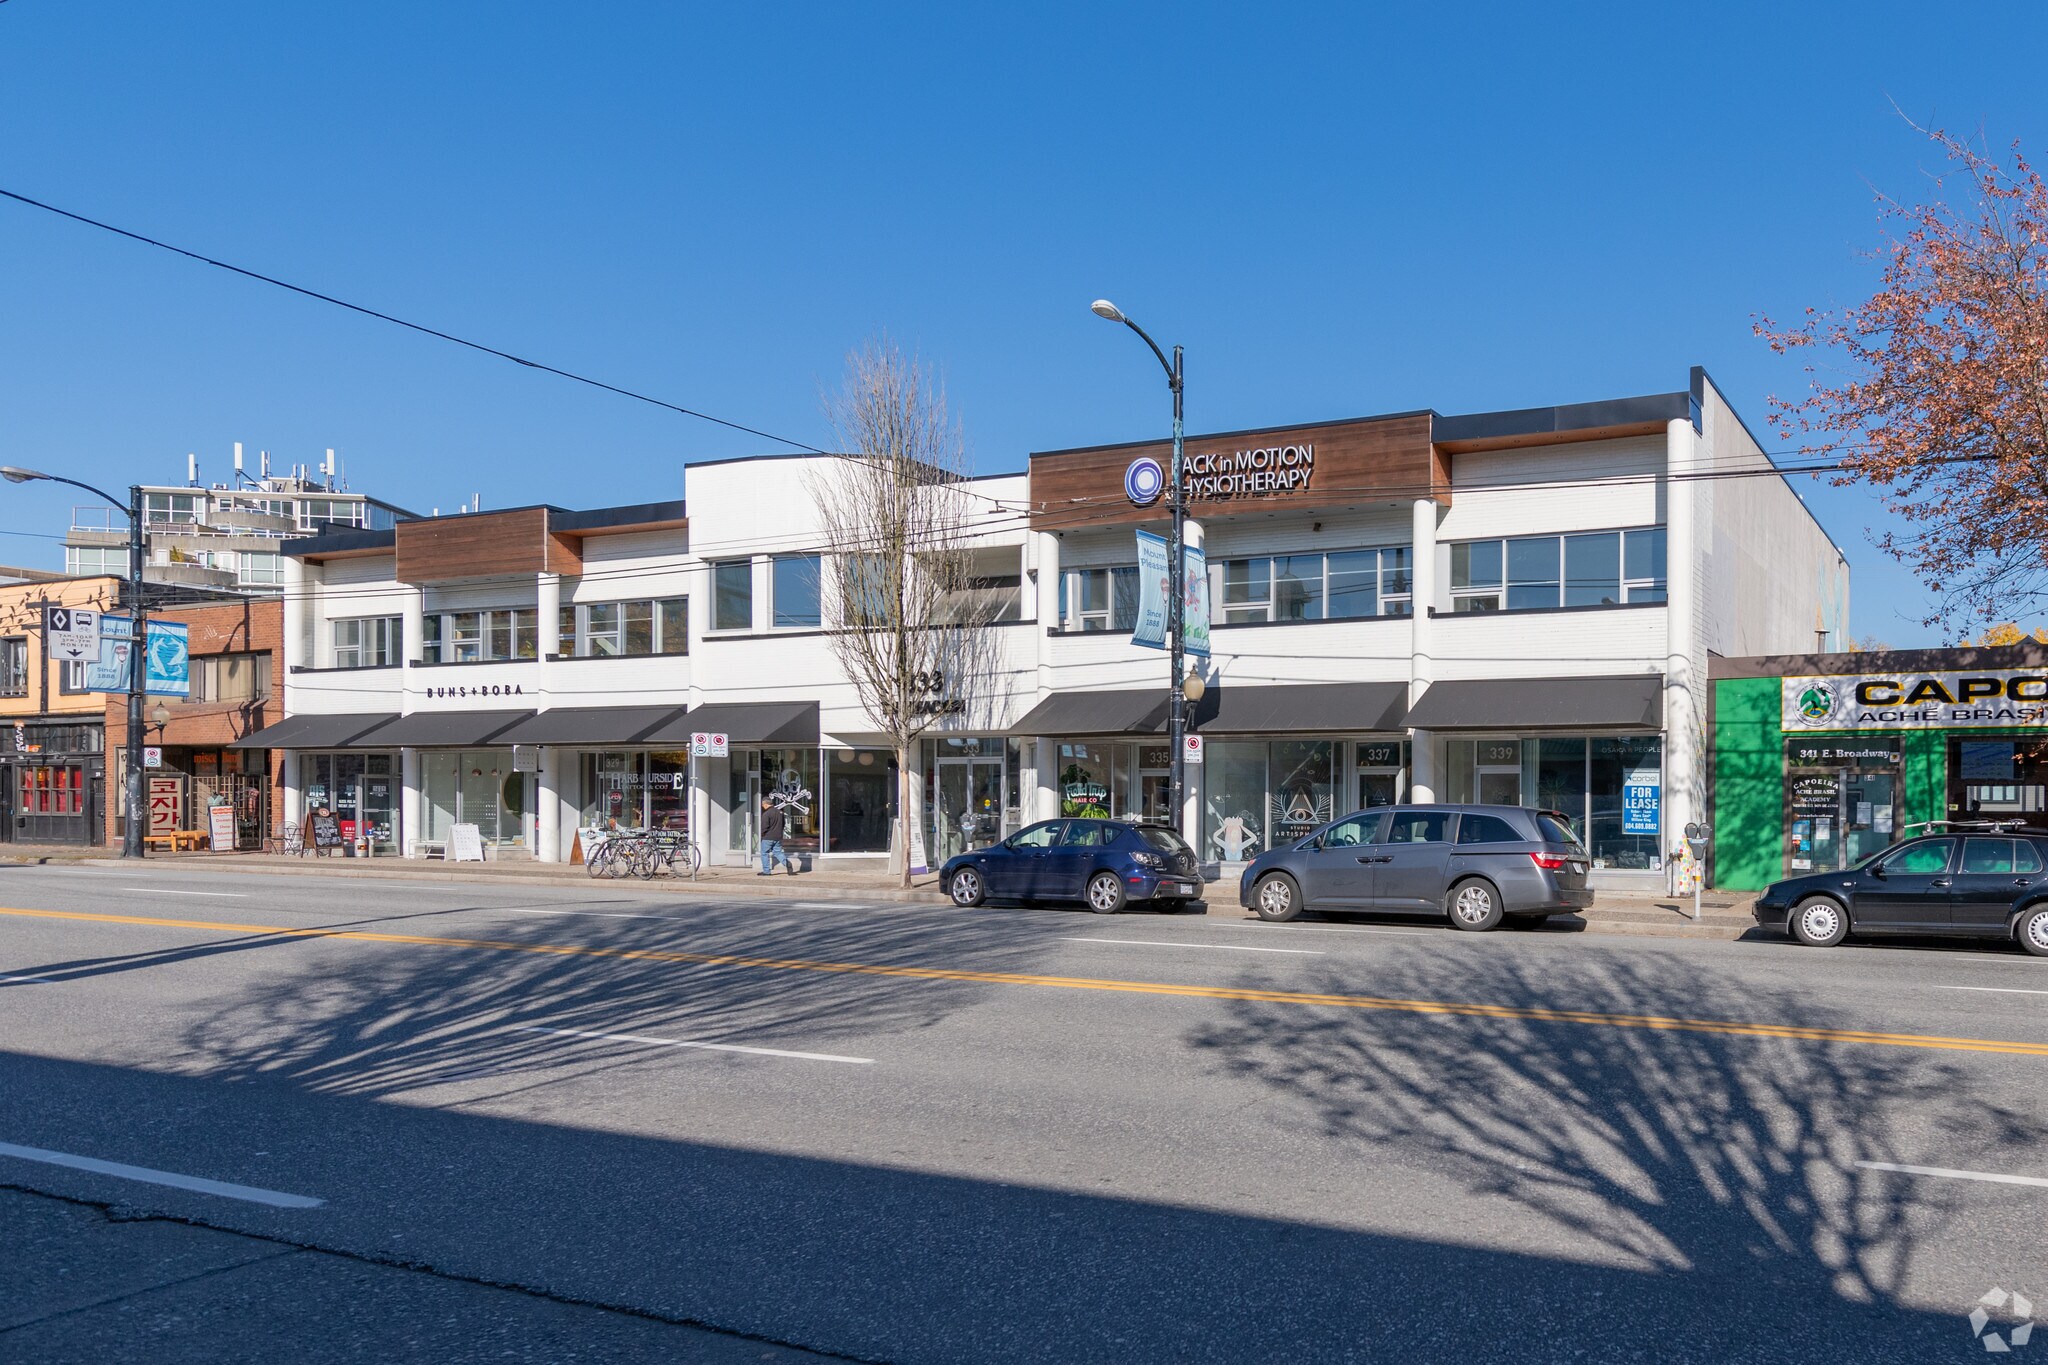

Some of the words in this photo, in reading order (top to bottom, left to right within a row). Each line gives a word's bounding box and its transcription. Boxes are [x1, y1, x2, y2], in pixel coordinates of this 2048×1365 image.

[1171, 454, 1217, 476] ACK
[1220, 456, 1232, 471] in
[1236, 444, 1312, 471] MOTION
[1171, 468, 1312, 496] HYSIOTHERAPY
[1143, 547, 1166, 561] Mount
[1146, 609, 1162, 619] Since
[1145, 619, 1160, 628] 1888
[1857, 707, 1939, 723] ACHÉ
[1150, 752, 1169, 763] 335
[1368, 749, 1390, 760] 337
[1489, 747, 1513, 760] 339
[1800, 749, 1818, 758] 341
[1822, 749, 1832, 758] E.
[1836, 748, 1890, 759] Broadway
[605, 758, 620, 768] 329
[1793, 778, 1839, 790] CAPOEIRA
[1631, 787, 1652, 798] FOR
[1625, 798, 1658, 809] LEASE
